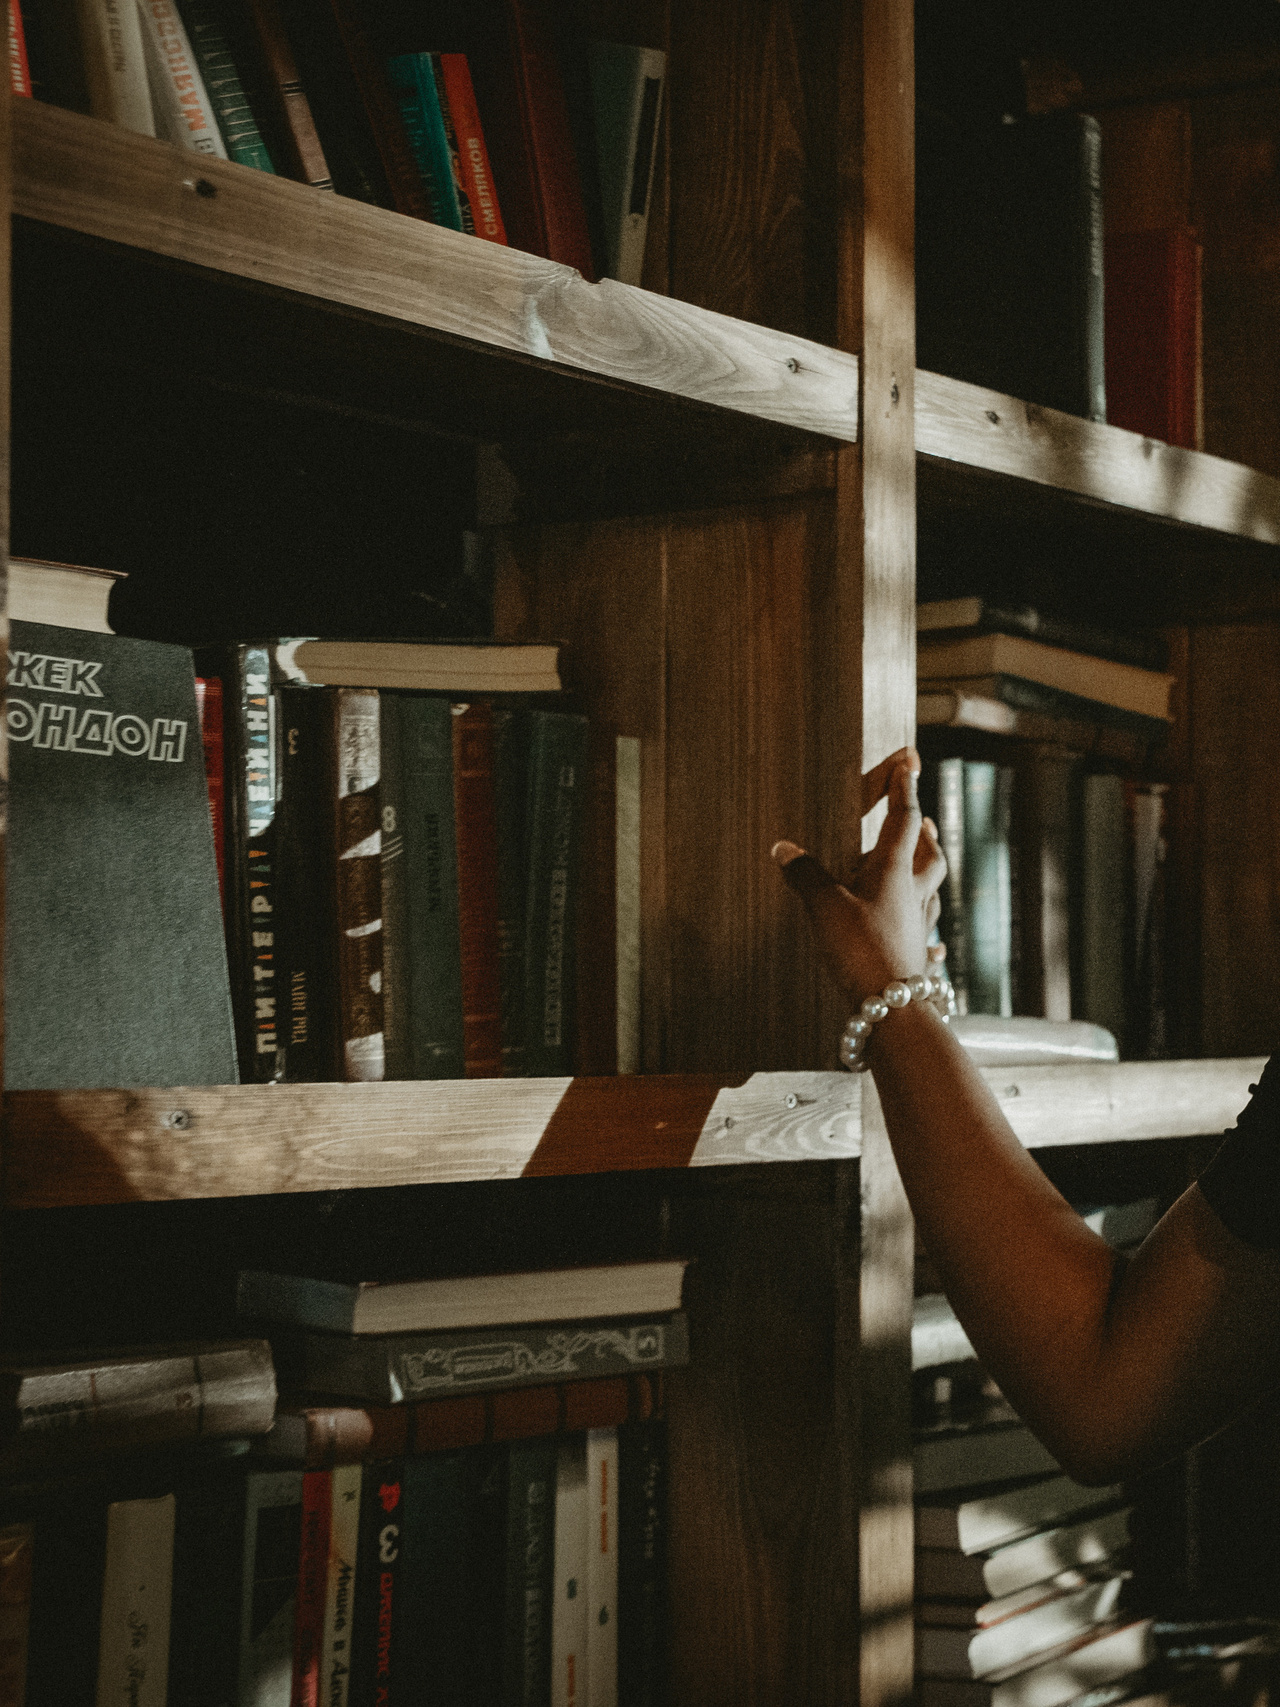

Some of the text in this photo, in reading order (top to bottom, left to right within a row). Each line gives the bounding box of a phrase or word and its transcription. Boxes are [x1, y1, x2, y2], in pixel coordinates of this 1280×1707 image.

[152, 0, 207, 132] МАЯКОВС
[466, 137, 499, 236] СМЕЛЯКОВ
[382, 805, 397, 833] 8
[250, 895, 278, 1054] ПИТЕР
